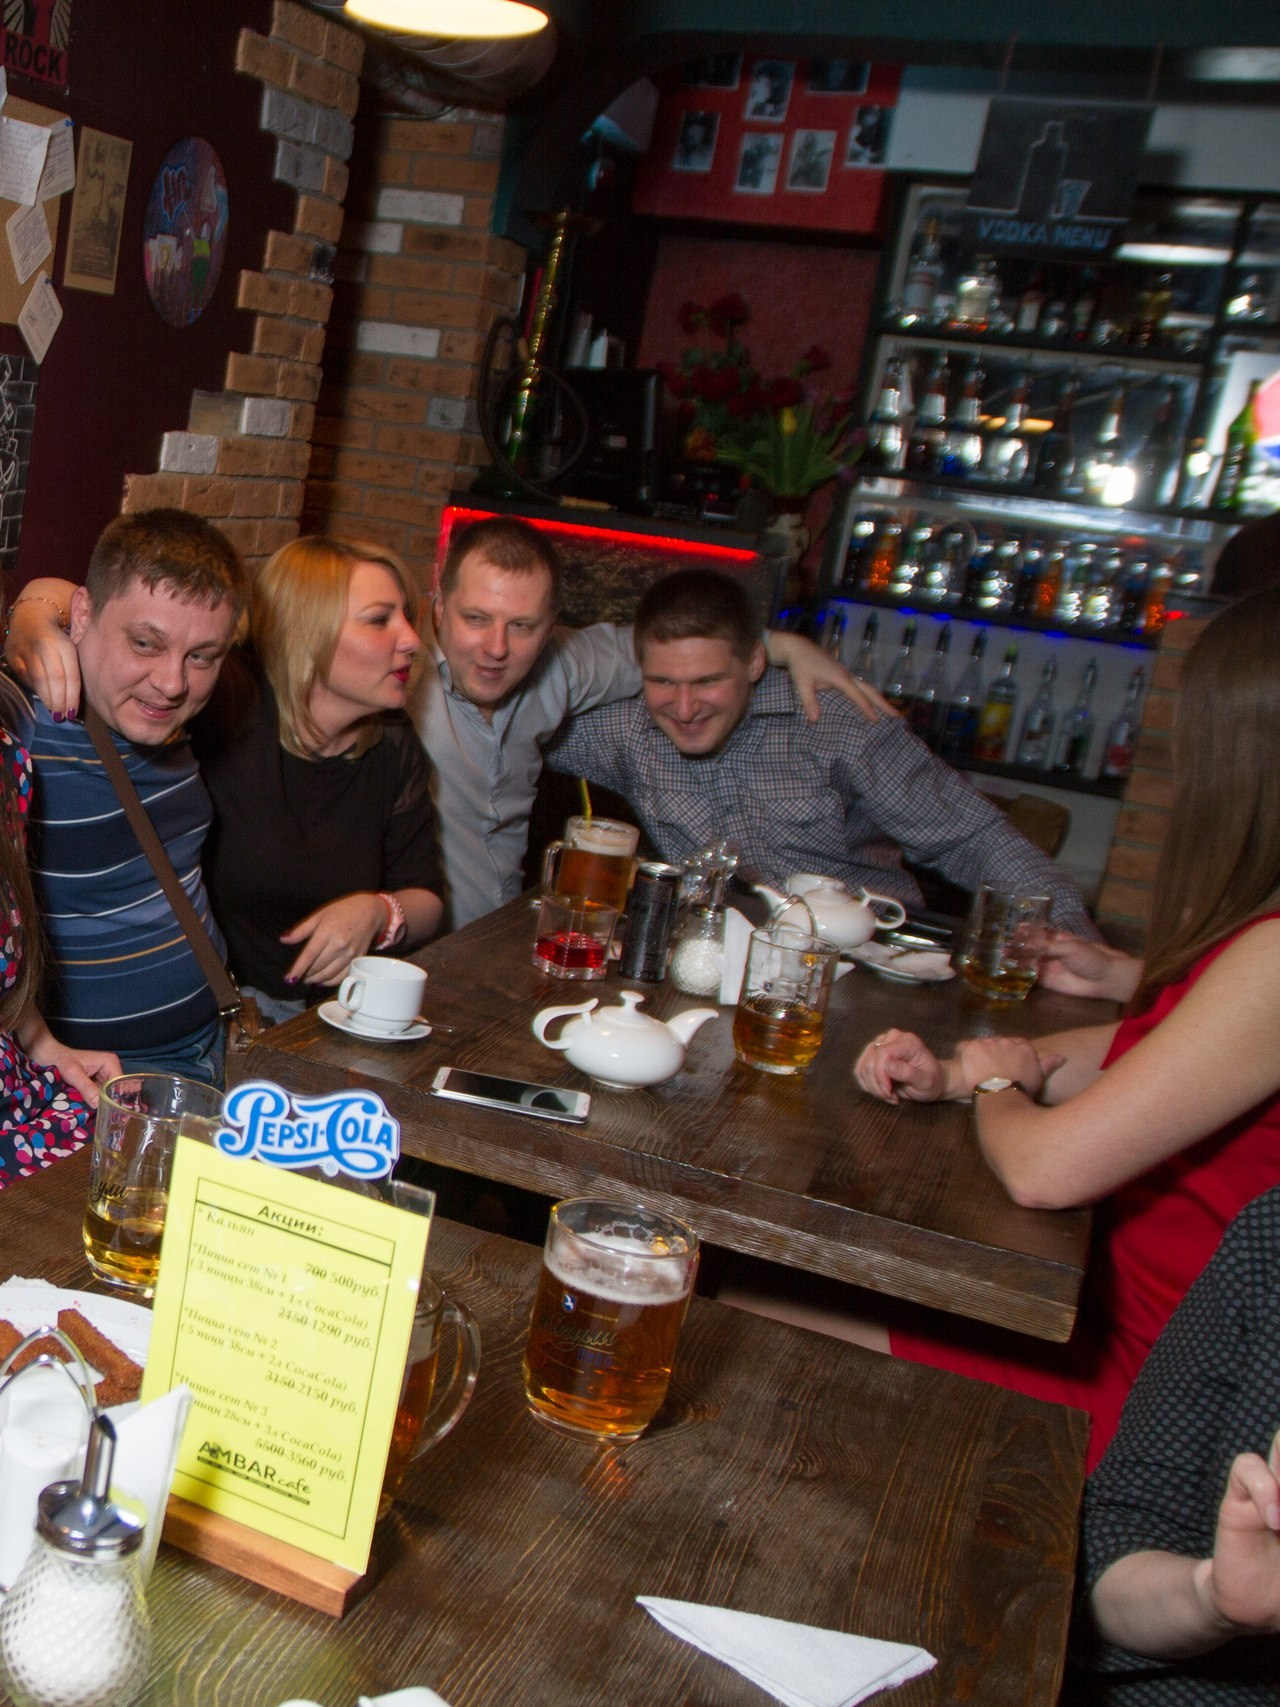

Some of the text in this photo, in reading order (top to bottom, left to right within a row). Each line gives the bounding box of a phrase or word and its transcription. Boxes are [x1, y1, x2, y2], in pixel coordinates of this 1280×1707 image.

[4, 32, 62, 81] ROCK
[979, 218, 1112, 250] VODKA MENU
[206, 1210, 256, 1237] Кальян
[257, 1205, 325, 1237] Акции:
[206, 1265, 244, 1286] пиццы
[237, 1260, 261, 1275] сет
[197, 1329, 225, 1349] пицц
[230, 1339, 255, 1358] 38см
[228, 1326, 251, 1340] сет
[270, 1339, 278, 1350] 2
[343, 1332, 373, 1351] руб.
[219, 1393, 241, 1407] сет
[261, 1406, 269, 1416] 3
[330, 1397, 359, 1416] руб.
[223, 1408, 252, 1427] 28см
[319, 1464, 348, 1483] руб.
[277, 1478, 313, 1495] cafe
